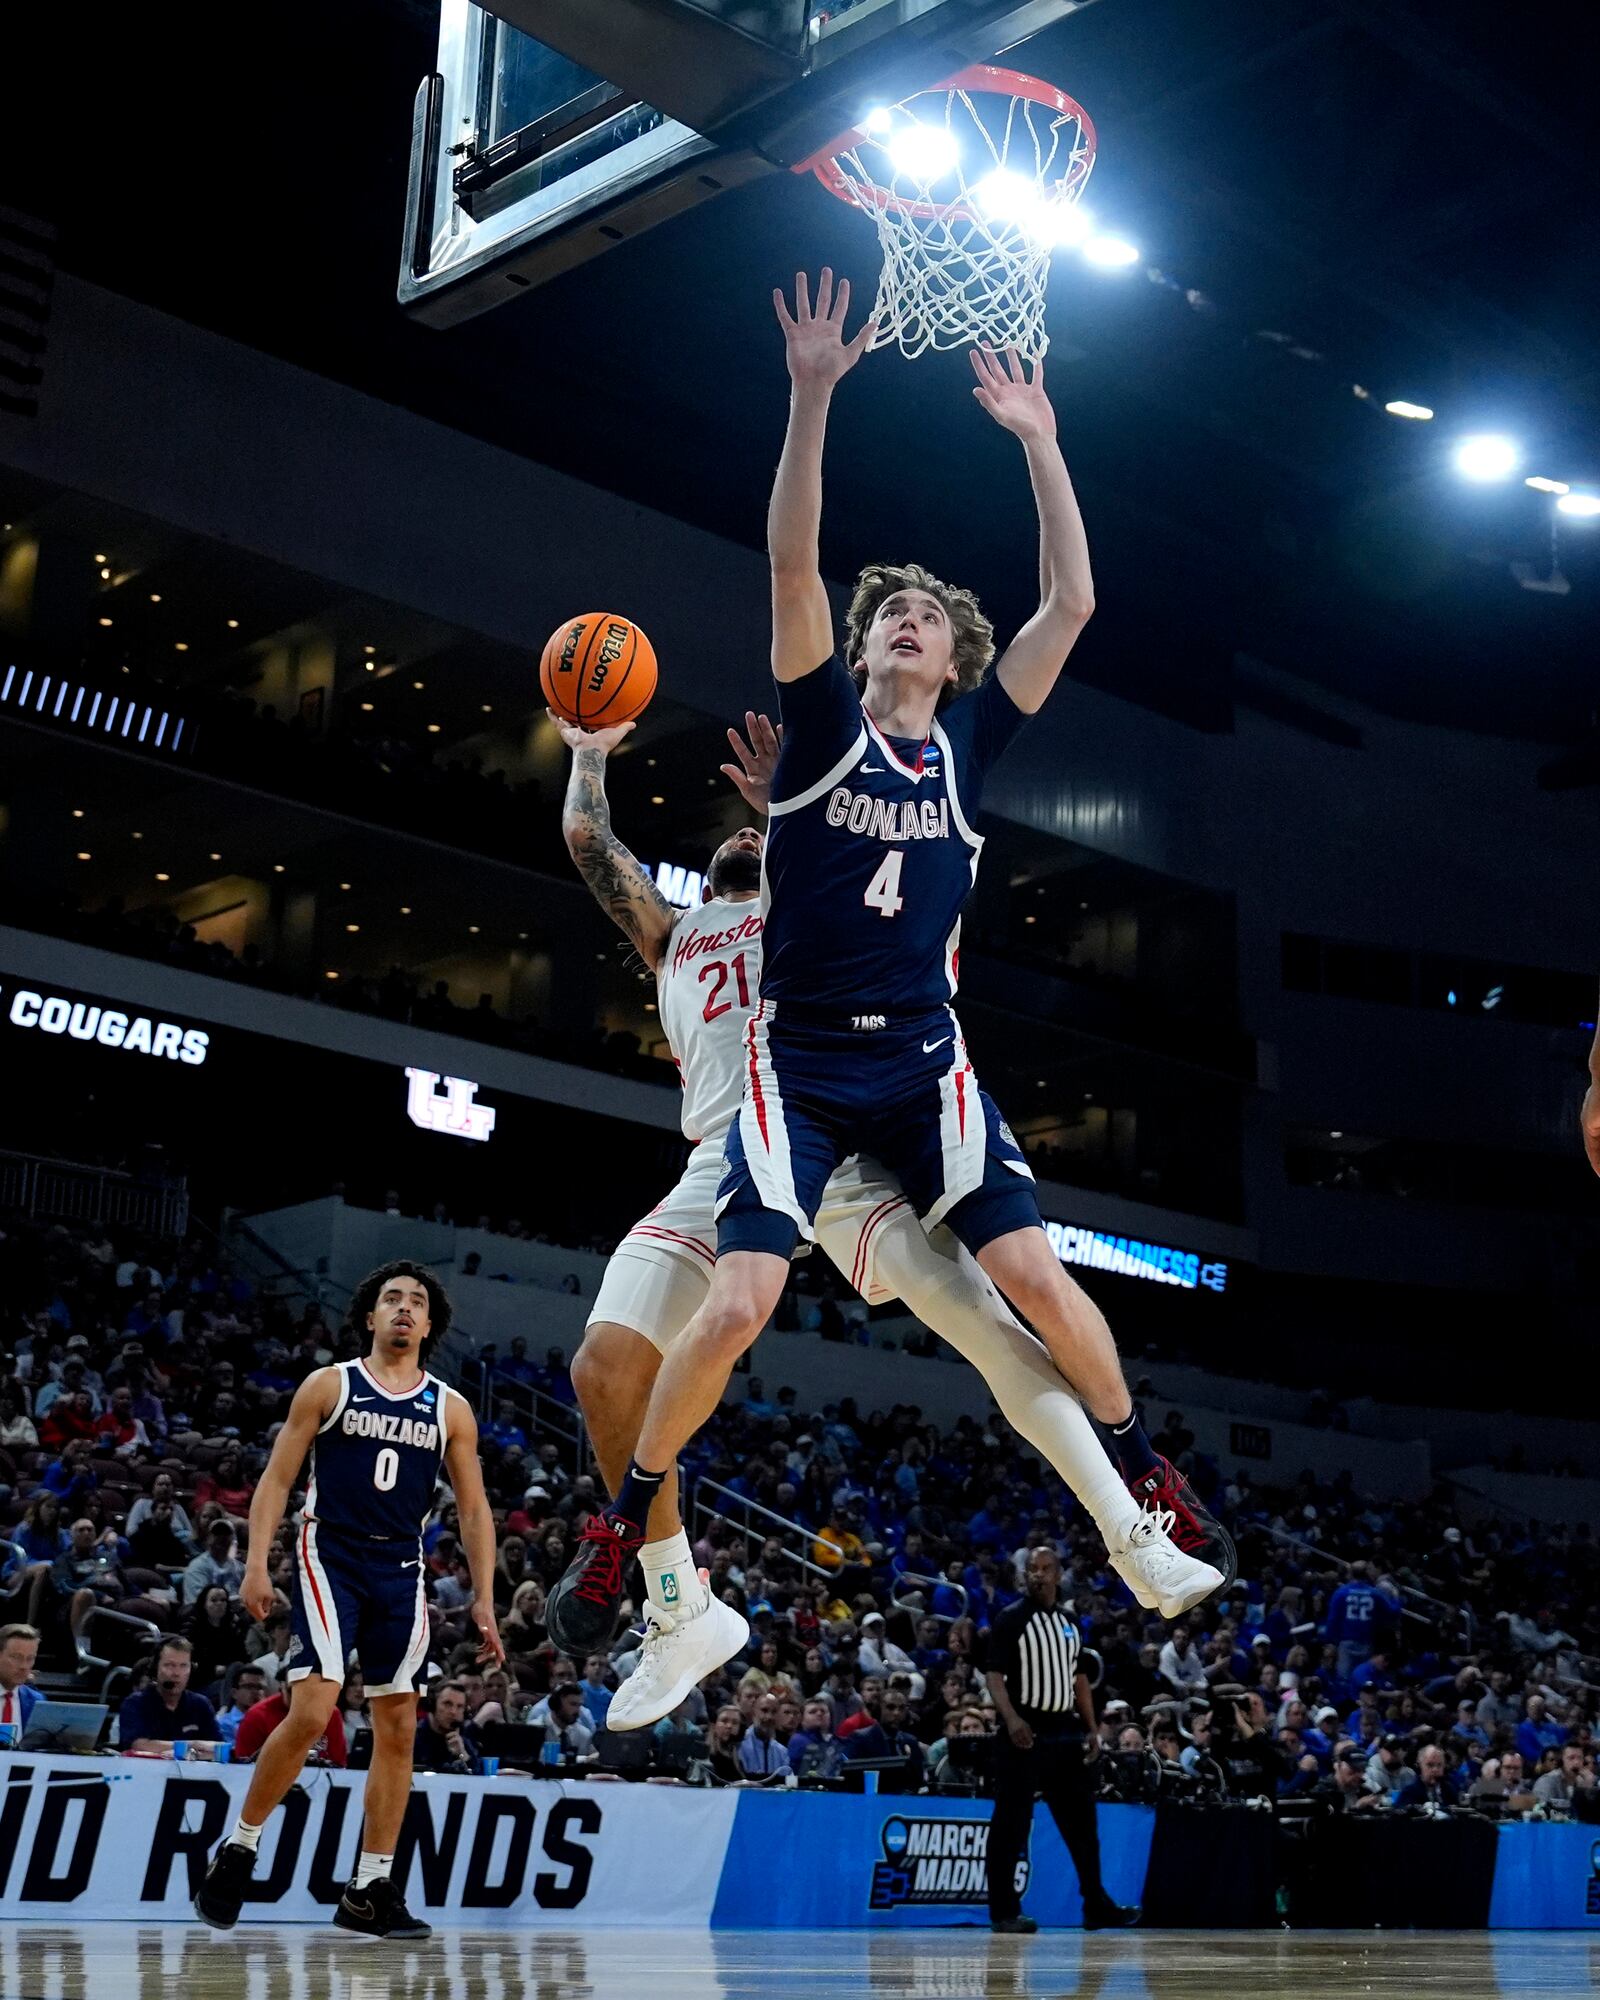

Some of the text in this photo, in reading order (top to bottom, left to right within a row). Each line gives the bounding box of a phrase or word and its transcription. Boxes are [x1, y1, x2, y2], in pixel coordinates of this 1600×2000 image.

[558, 622, 587, 673] NCAA
[586, 622, 629, 692] Wilson
[864, 850, 905, 918] 4
[673, 915, 765, 978] Housto
[698, 952, 750, 1024] 21
[9, 990, 210, 1065] COUGARS
[851, 1014, 887, 1031] ZAGS
[342, 1408, 439, 1451] GONZAGA
[373, 1447, 400, 1492] 0
[1345, 1594, 1375, 1621] 22
[906, 1823, 991, 1858] MARCH
[913, 1858, 1029, 1893] MADNS
